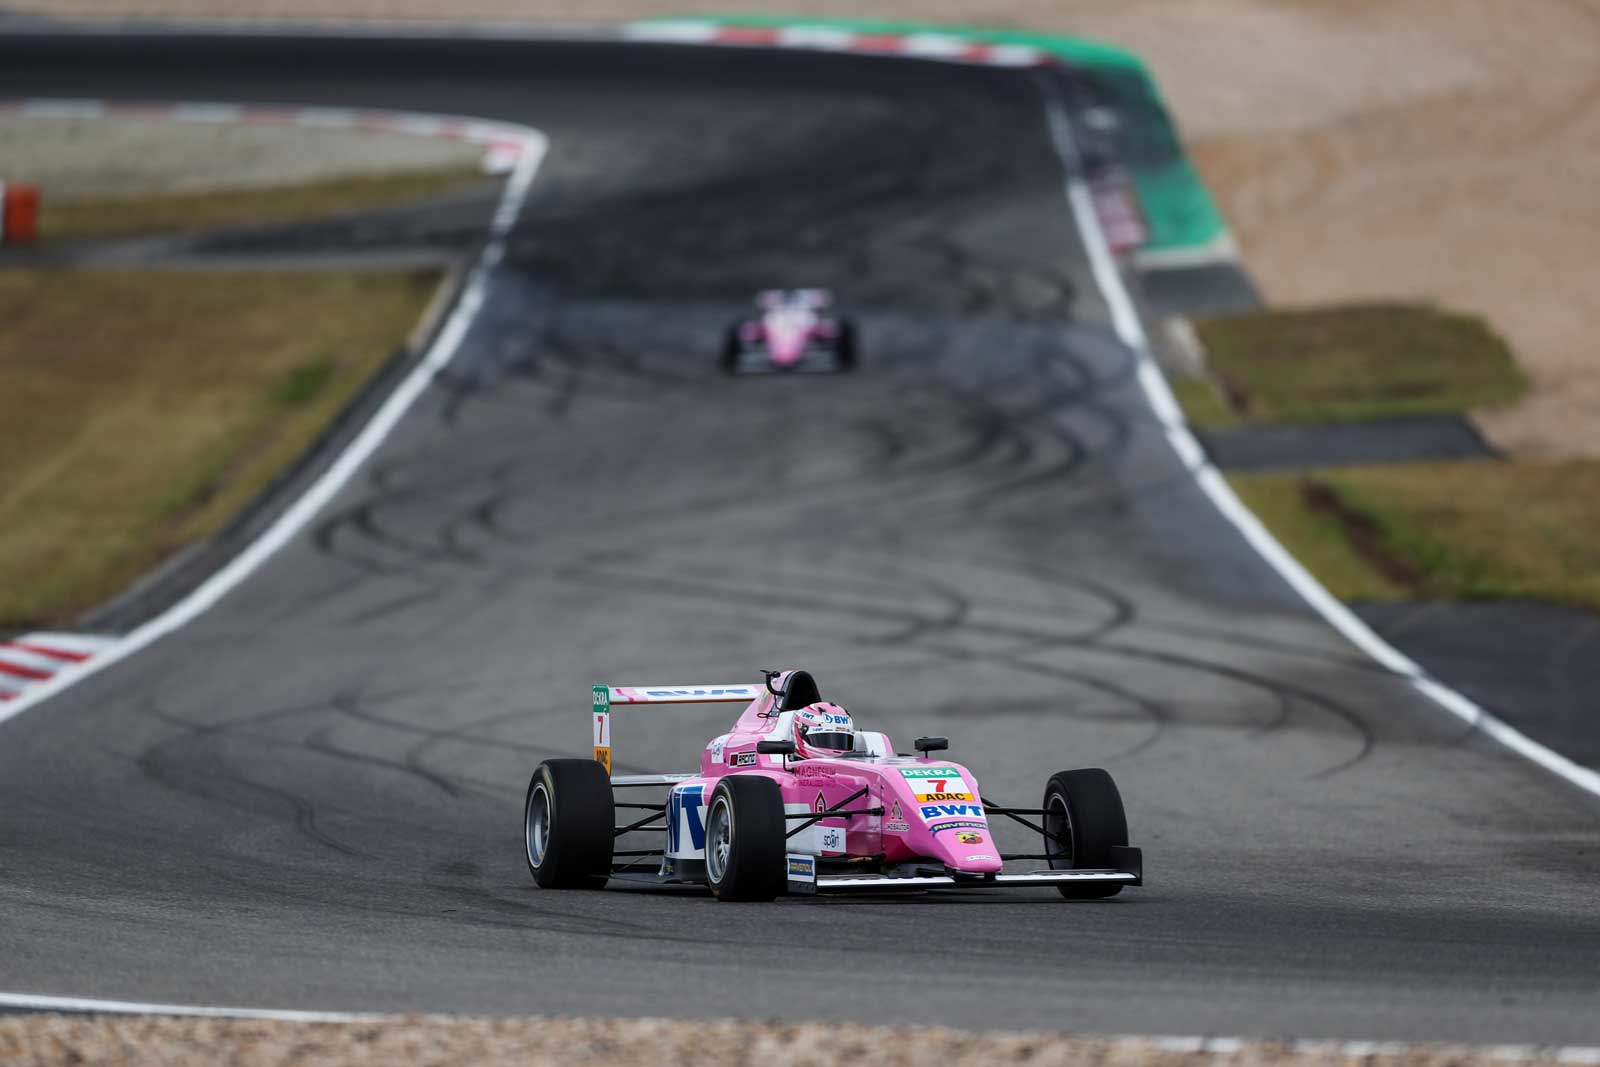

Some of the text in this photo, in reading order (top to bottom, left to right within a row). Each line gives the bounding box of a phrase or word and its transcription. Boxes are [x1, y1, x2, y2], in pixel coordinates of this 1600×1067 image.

[597, 715, 604, 745] 7
[900, 769, 958, 777] DEKRA
[927, 779, 948, 793] 7
[926, 792, 966, 801] ADAC
[920, 804, 983, 819] BWT
